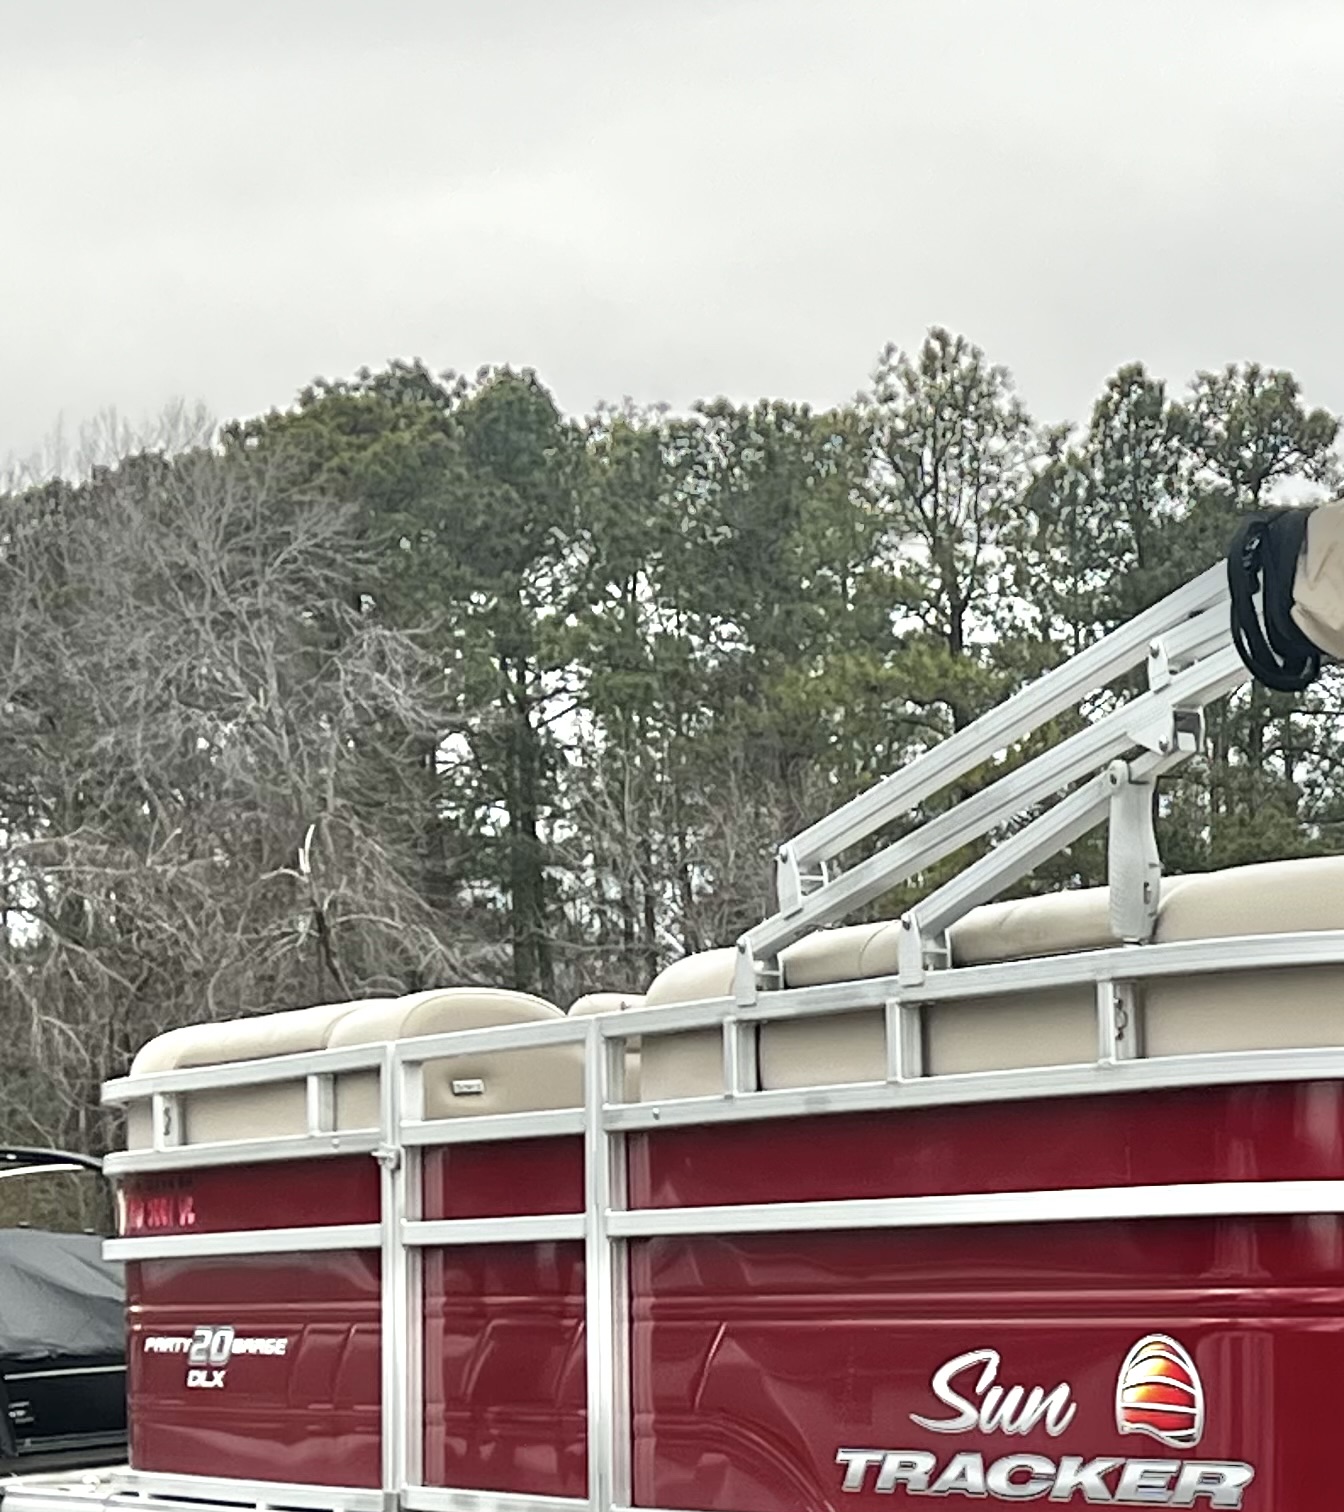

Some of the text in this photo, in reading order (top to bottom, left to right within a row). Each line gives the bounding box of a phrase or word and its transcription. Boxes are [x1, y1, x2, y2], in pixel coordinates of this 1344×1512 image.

[144, 1326, 288, 1367] PARTY 20 BARGE
[187, 1369, 227, 1388] DLX
[908, 1348, 1077, 1437] Sun
[835, 1447, 1255, 1510] TRACKER
